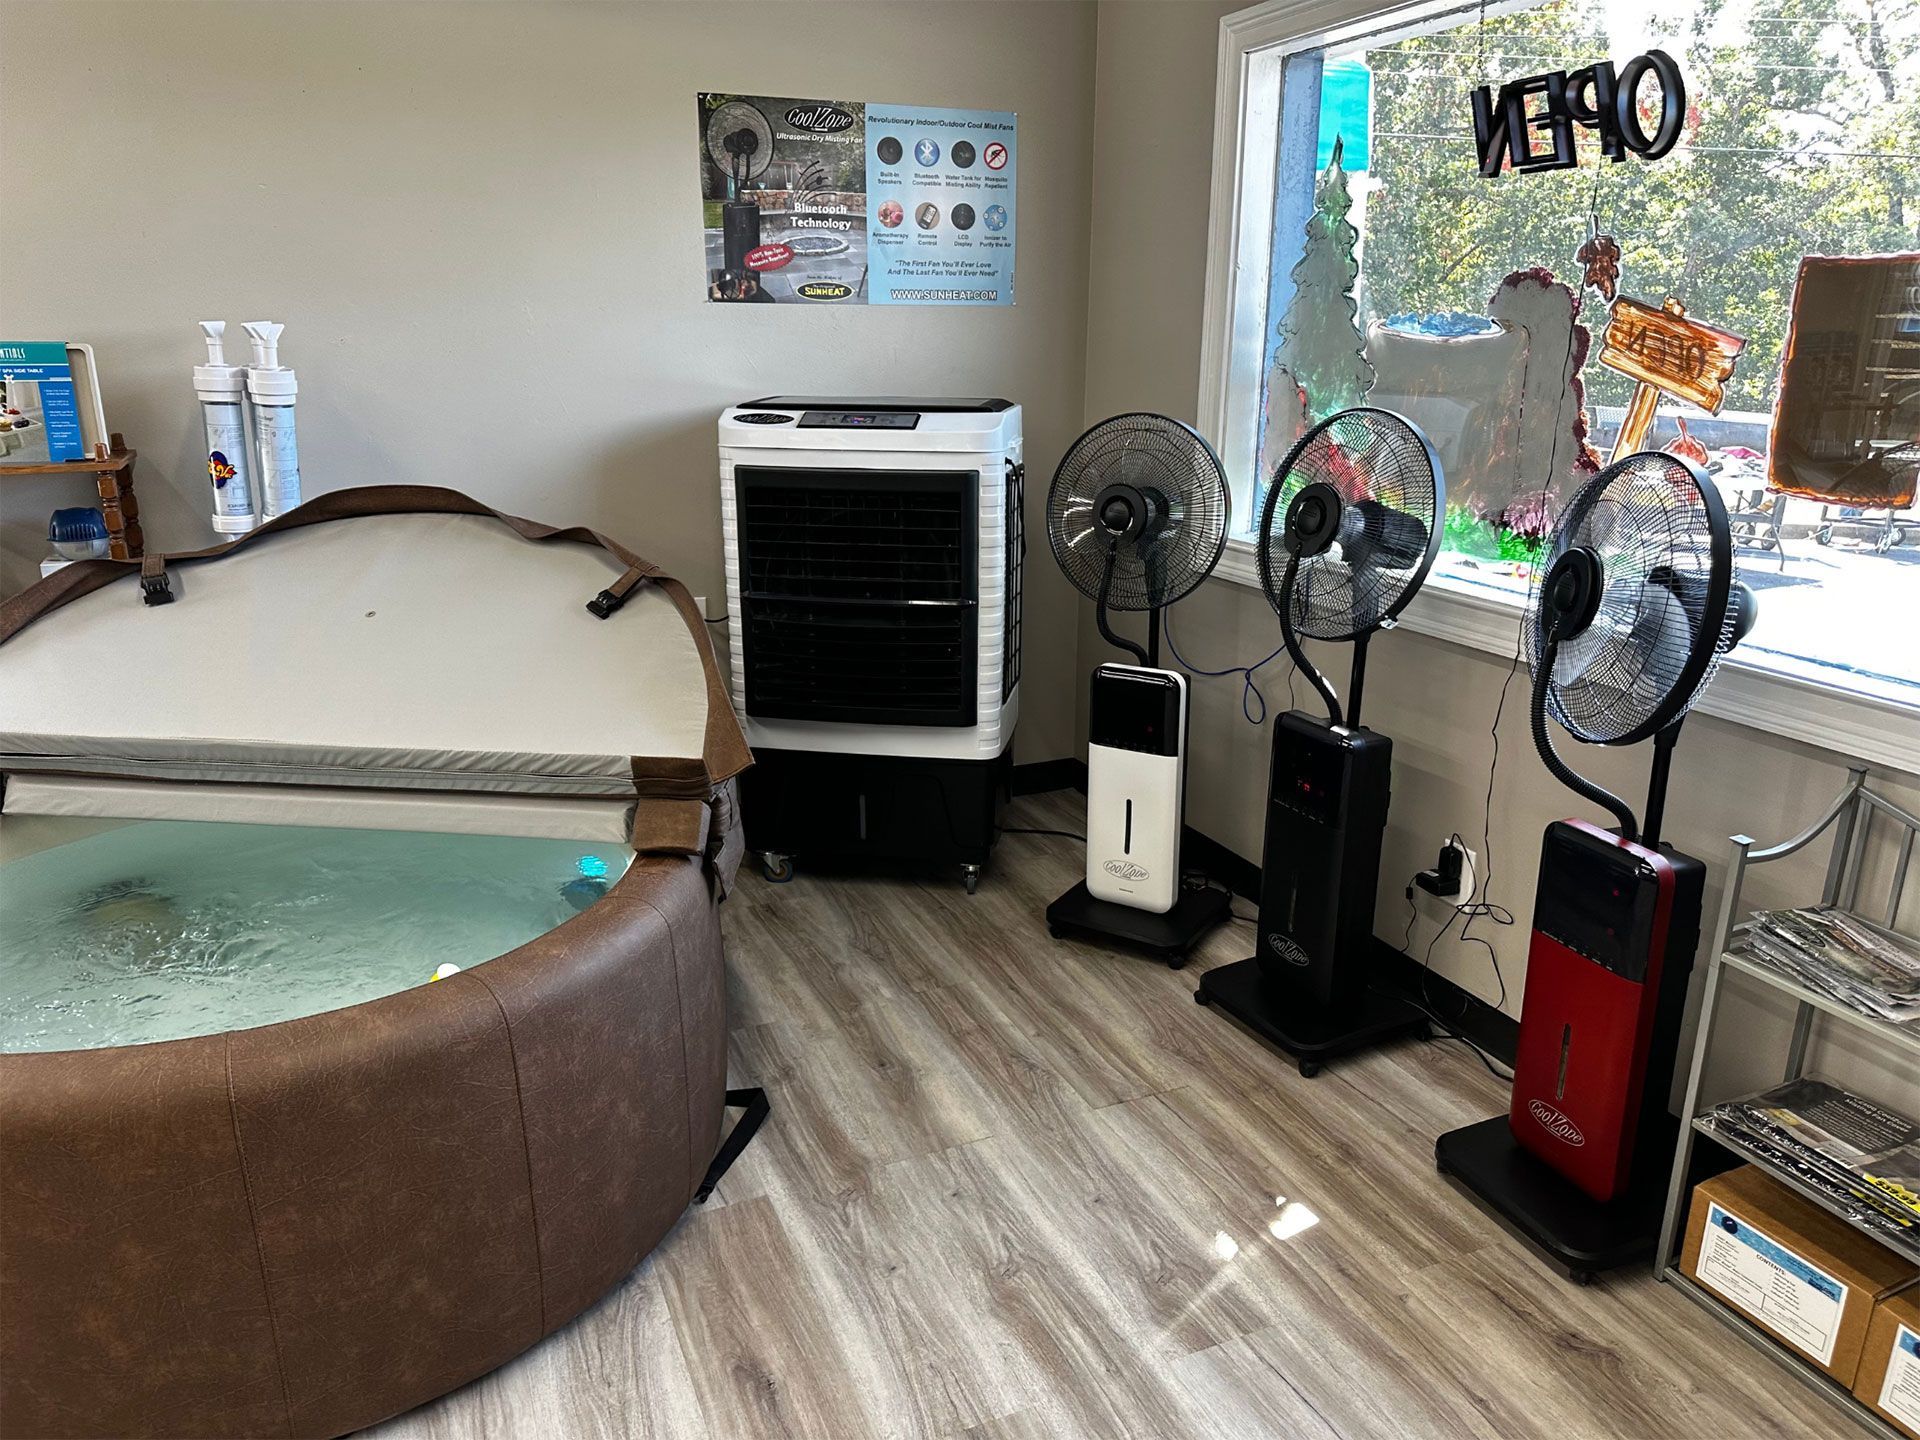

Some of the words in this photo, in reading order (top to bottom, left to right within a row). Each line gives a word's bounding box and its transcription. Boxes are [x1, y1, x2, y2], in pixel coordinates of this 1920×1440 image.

[788, 107, 852, 128] CoolZone
[868, 116, 914, 126] Revolutionary
[916, 120, 966, 128] Indoor/Outdoor
[776, 132, 811, 140] Ultrasonic
[812, 134, 824, 143] Dry
[825, 136, 850, 144] Misting
[794, 202, 847, 214] Bluetooth
[790, 216, 852, 230] Technology
[804, 286, 845, 296] SUNHEAT
[890, 289, 998, 300] WWW.SUNHEAT.COM
[1104, 862, 1149, 879] CoolZone
[1268, 934, 1308, 964] CoolZone
[1530, 1100, 1584, 1145] CoolZone
[1875, 1180, 1917, 1206] $39.99
